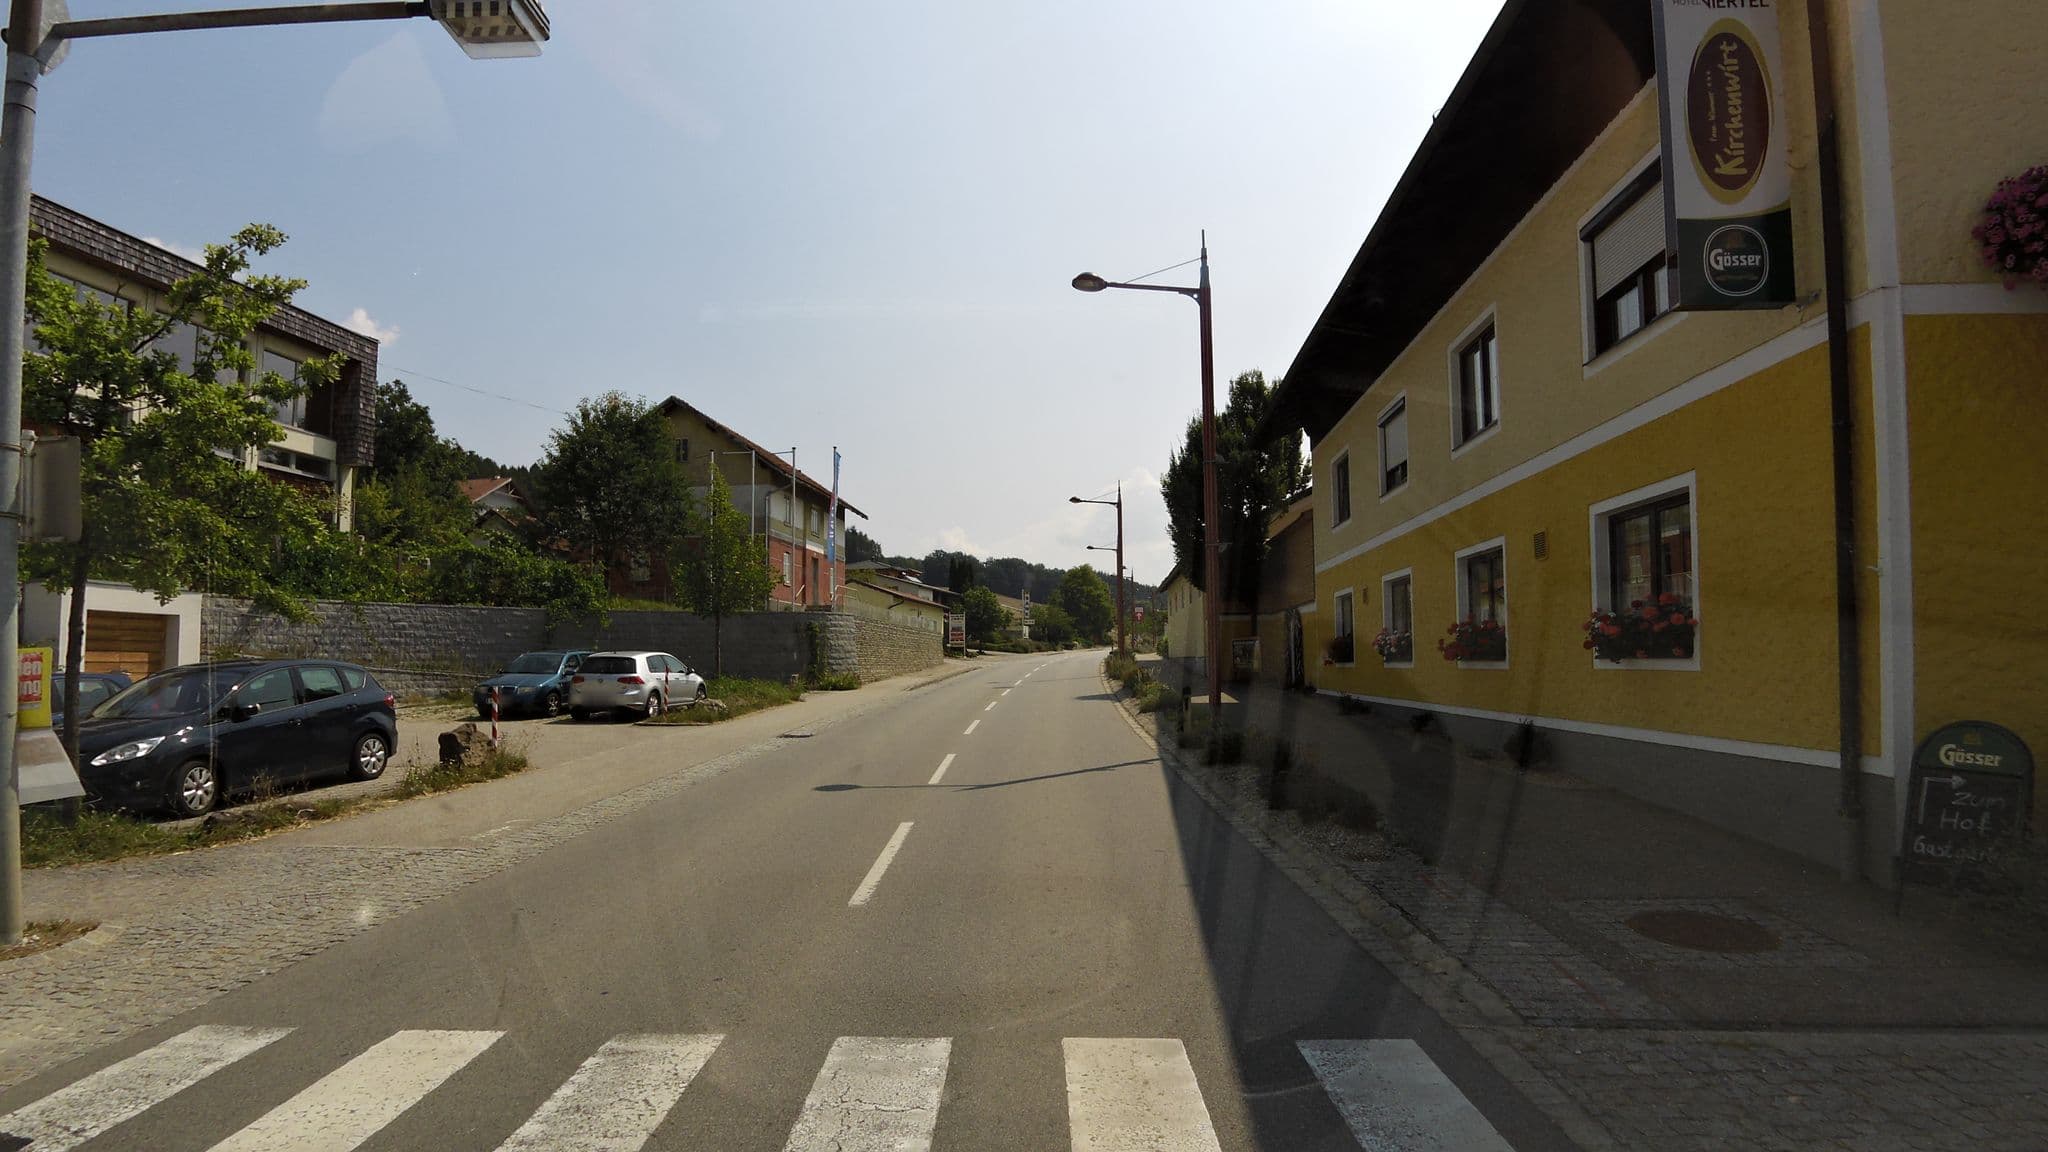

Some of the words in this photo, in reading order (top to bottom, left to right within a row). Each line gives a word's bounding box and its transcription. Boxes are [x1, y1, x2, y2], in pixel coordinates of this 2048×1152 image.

[1714, 40, 1748, 174] Kirchenwirt
[1710, 248, 1761, 271] Gösser
[1939, 743, 2003, 767] Gösser
